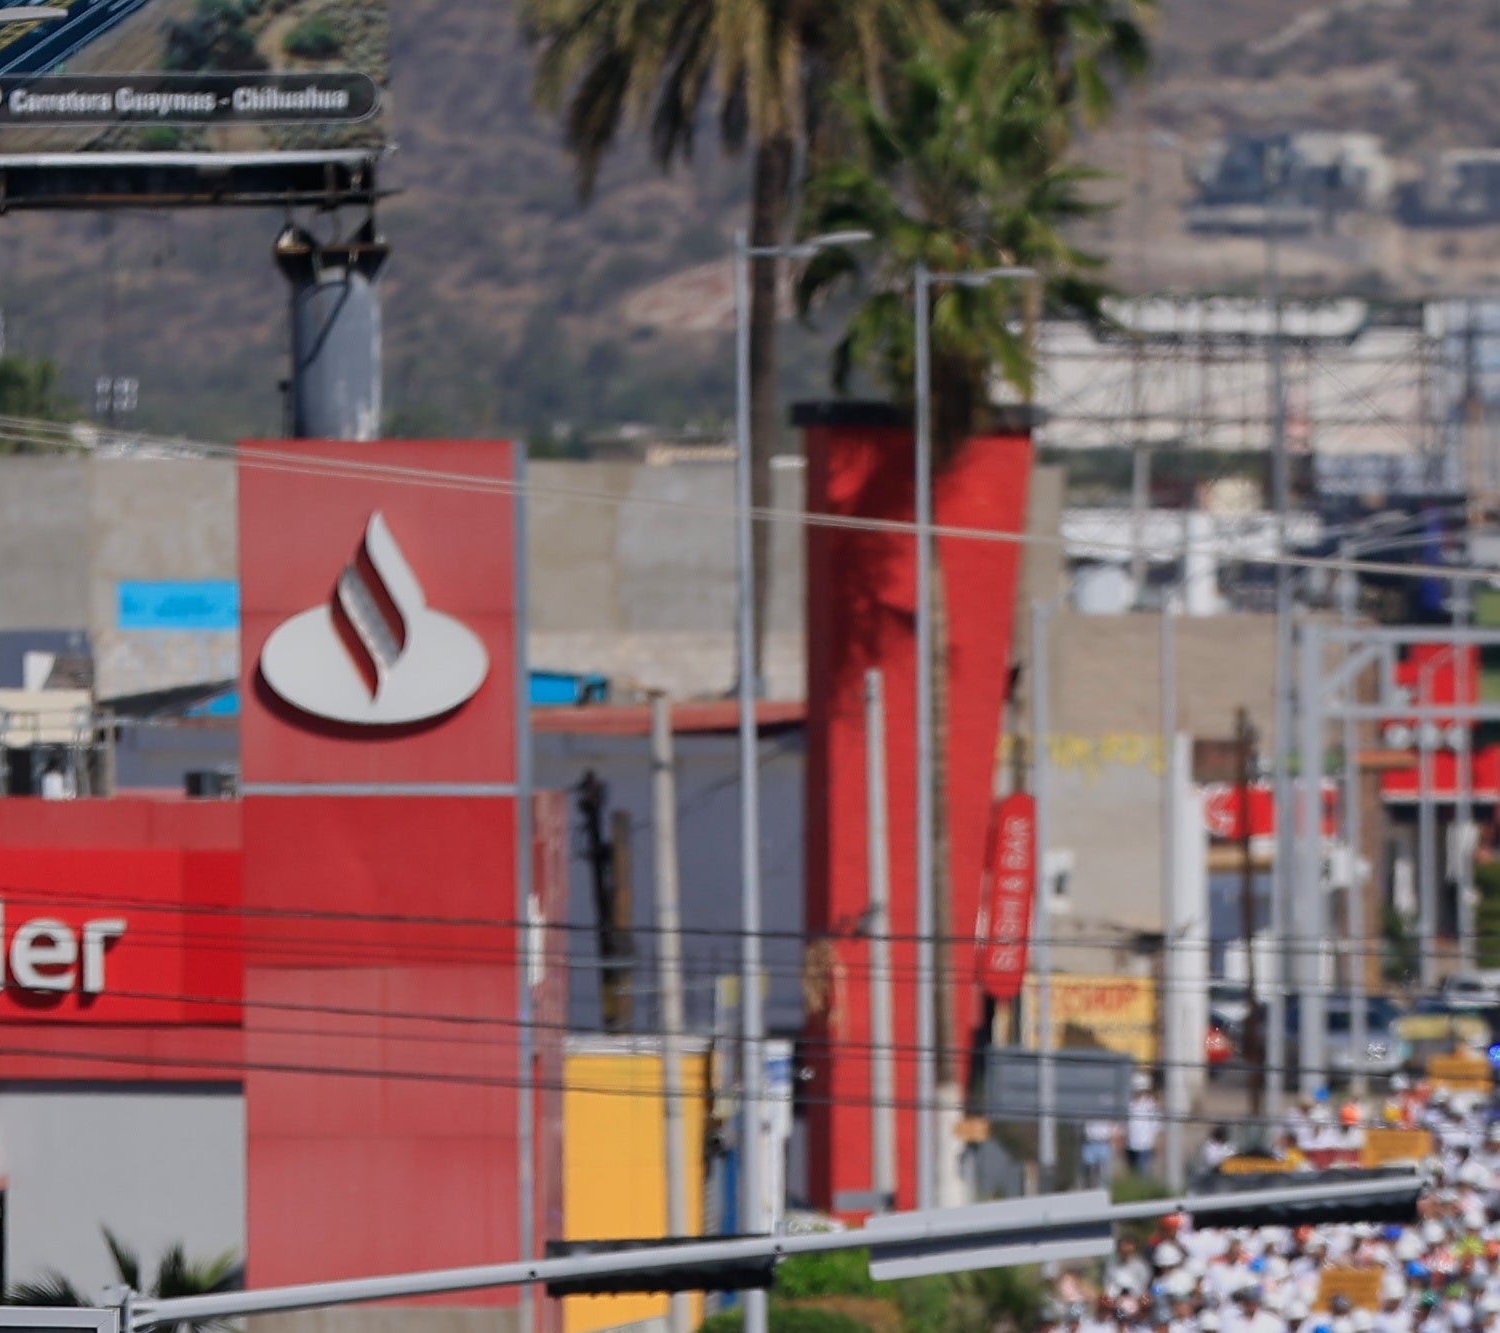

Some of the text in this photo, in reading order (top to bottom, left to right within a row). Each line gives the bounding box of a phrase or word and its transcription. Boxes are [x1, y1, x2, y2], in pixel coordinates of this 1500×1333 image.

[115, 86, 217, 116] Guaymas
[232, 85, 349, 111] Chihuahua
[1003, 817, 1031, 868] BAR
[989, 901, 1027, 972] SUSHI
